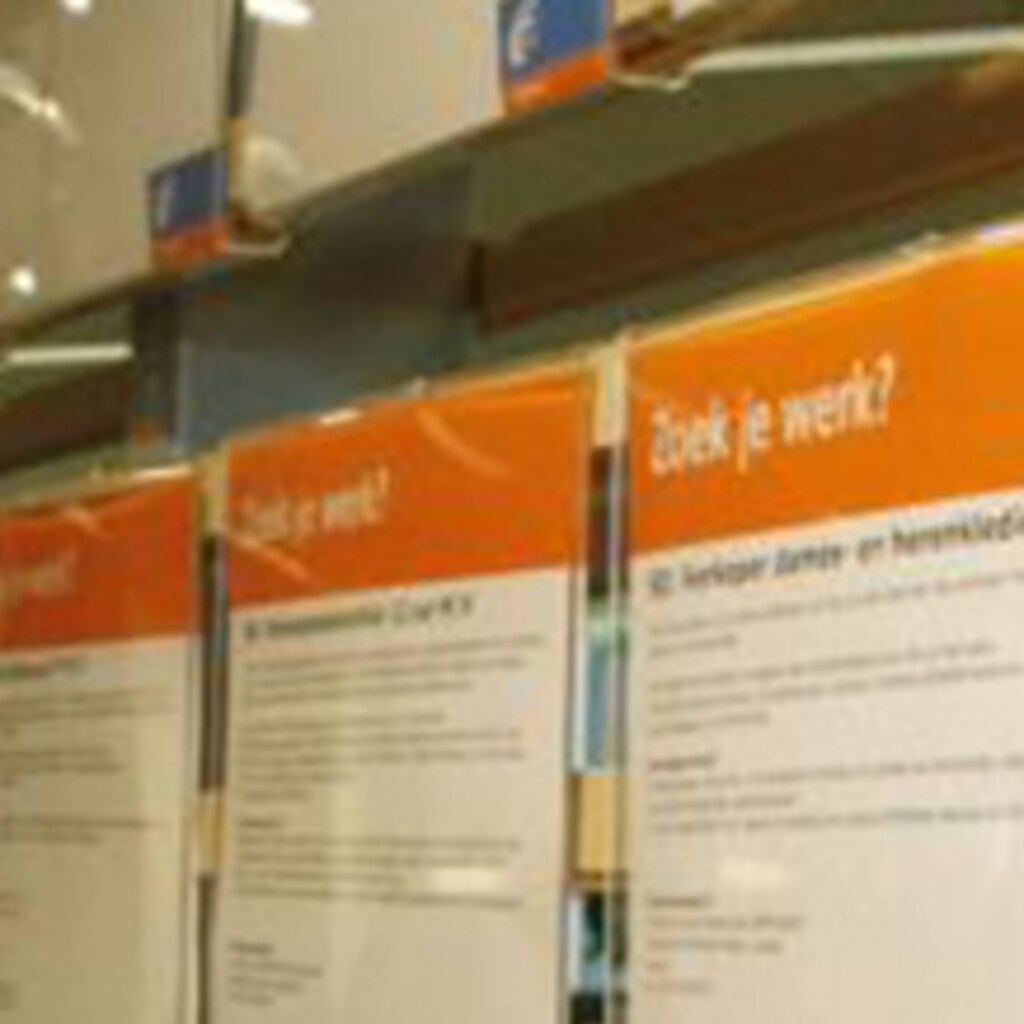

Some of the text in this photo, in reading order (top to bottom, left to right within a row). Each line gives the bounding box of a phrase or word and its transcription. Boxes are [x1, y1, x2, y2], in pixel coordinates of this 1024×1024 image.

[649, 352, 897, 476] Zoek je werk?
